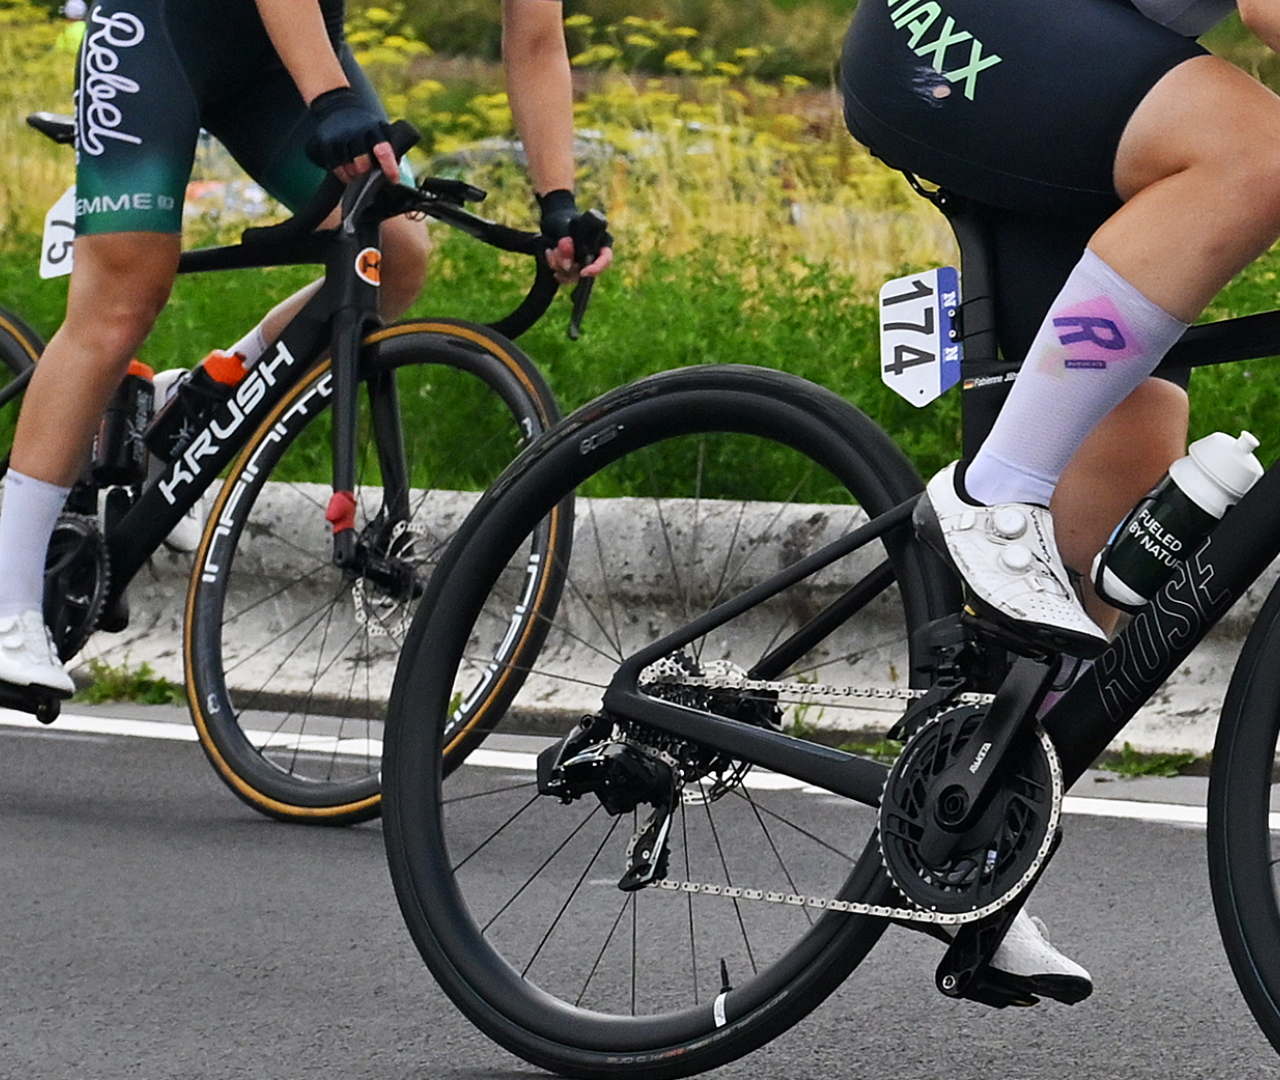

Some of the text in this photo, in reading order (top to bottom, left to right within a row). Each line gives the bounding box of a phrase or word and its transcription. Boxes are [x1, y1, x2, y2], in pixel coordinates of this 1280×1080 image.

[81, 4, 145, 156] Rebel
[882, 279, 936, 377] 174
[158, 340, 295, 505] KRUSH
[1128, 520, 1145, 538] BY
[1138, 508, 1183, 552] FUELED
[1093, 535, 1233, 722] ROSE
